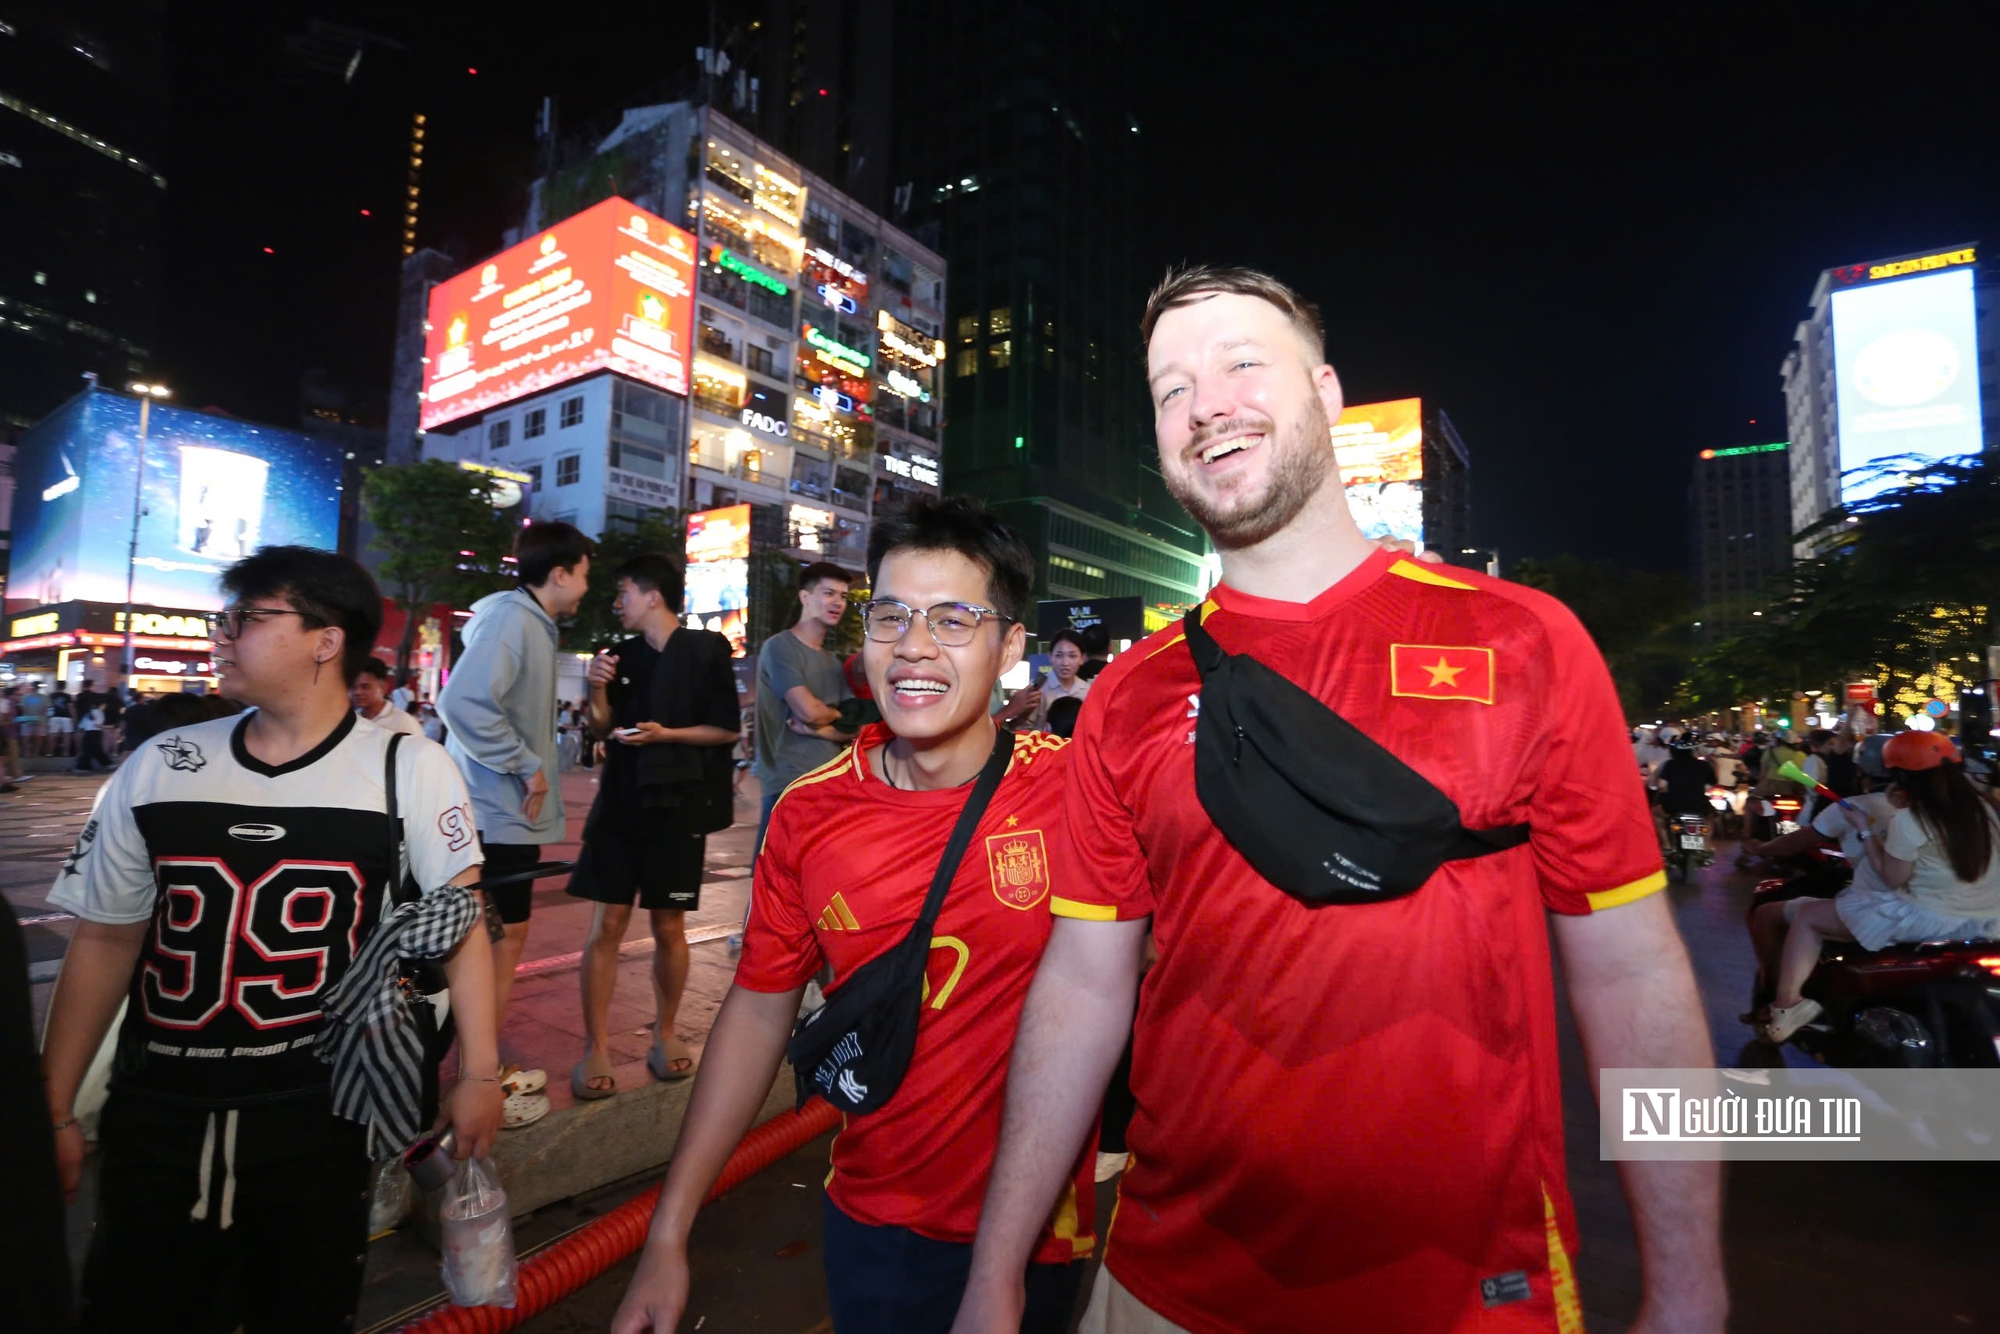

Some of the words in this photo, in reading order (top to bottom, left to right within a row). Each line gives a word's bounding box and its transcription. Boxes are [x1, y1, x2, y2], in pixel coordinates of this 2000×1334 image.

[883, 454, 911, 478] THE
[911, 465, 939, 487] ONE
[142, 856, 366, 1030] 99
[231, 1042, 289, 1057] DREAM
